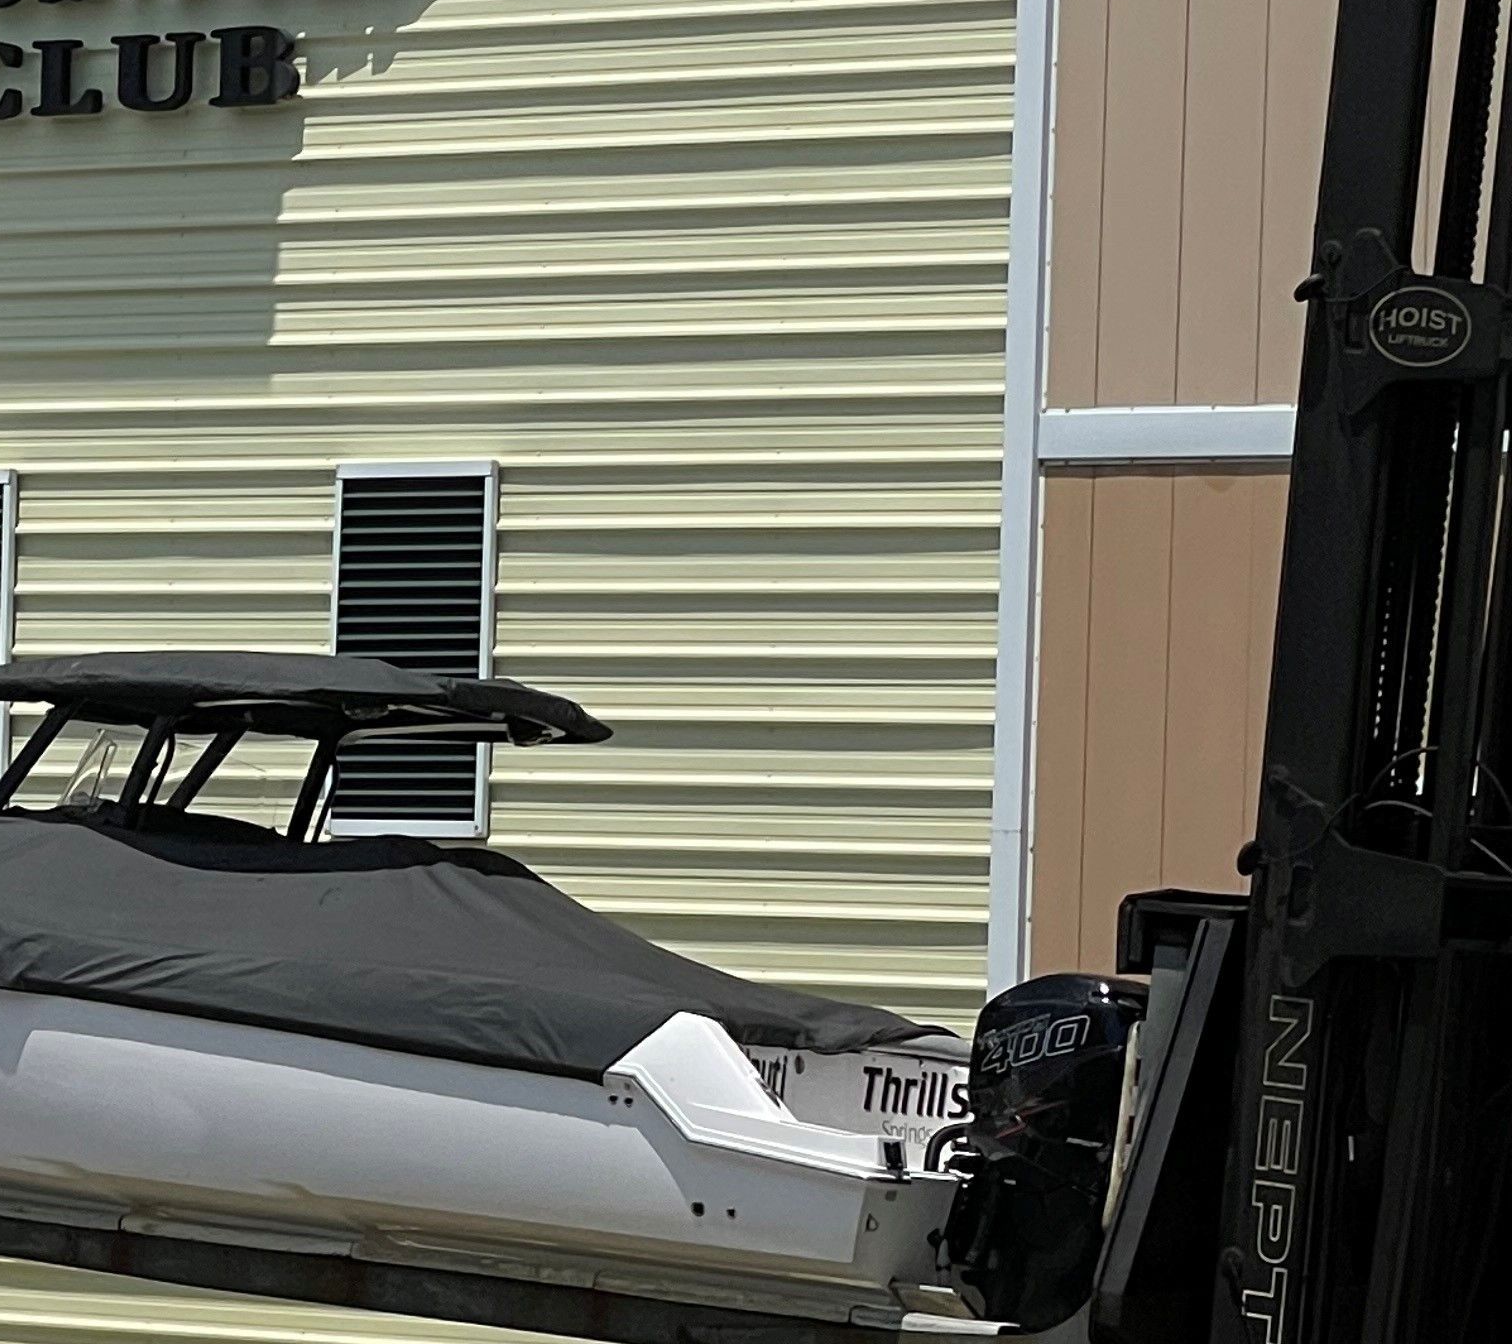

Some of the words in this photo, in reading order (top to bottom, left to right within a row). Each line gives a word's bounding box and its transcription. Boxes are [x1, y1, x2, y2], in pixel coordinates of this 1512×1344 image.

[1378, 306, 1463, 335] HOIST
[980, 1014, 1091, 1075] 400
[862, 1065, 971, 1119] Thrills
